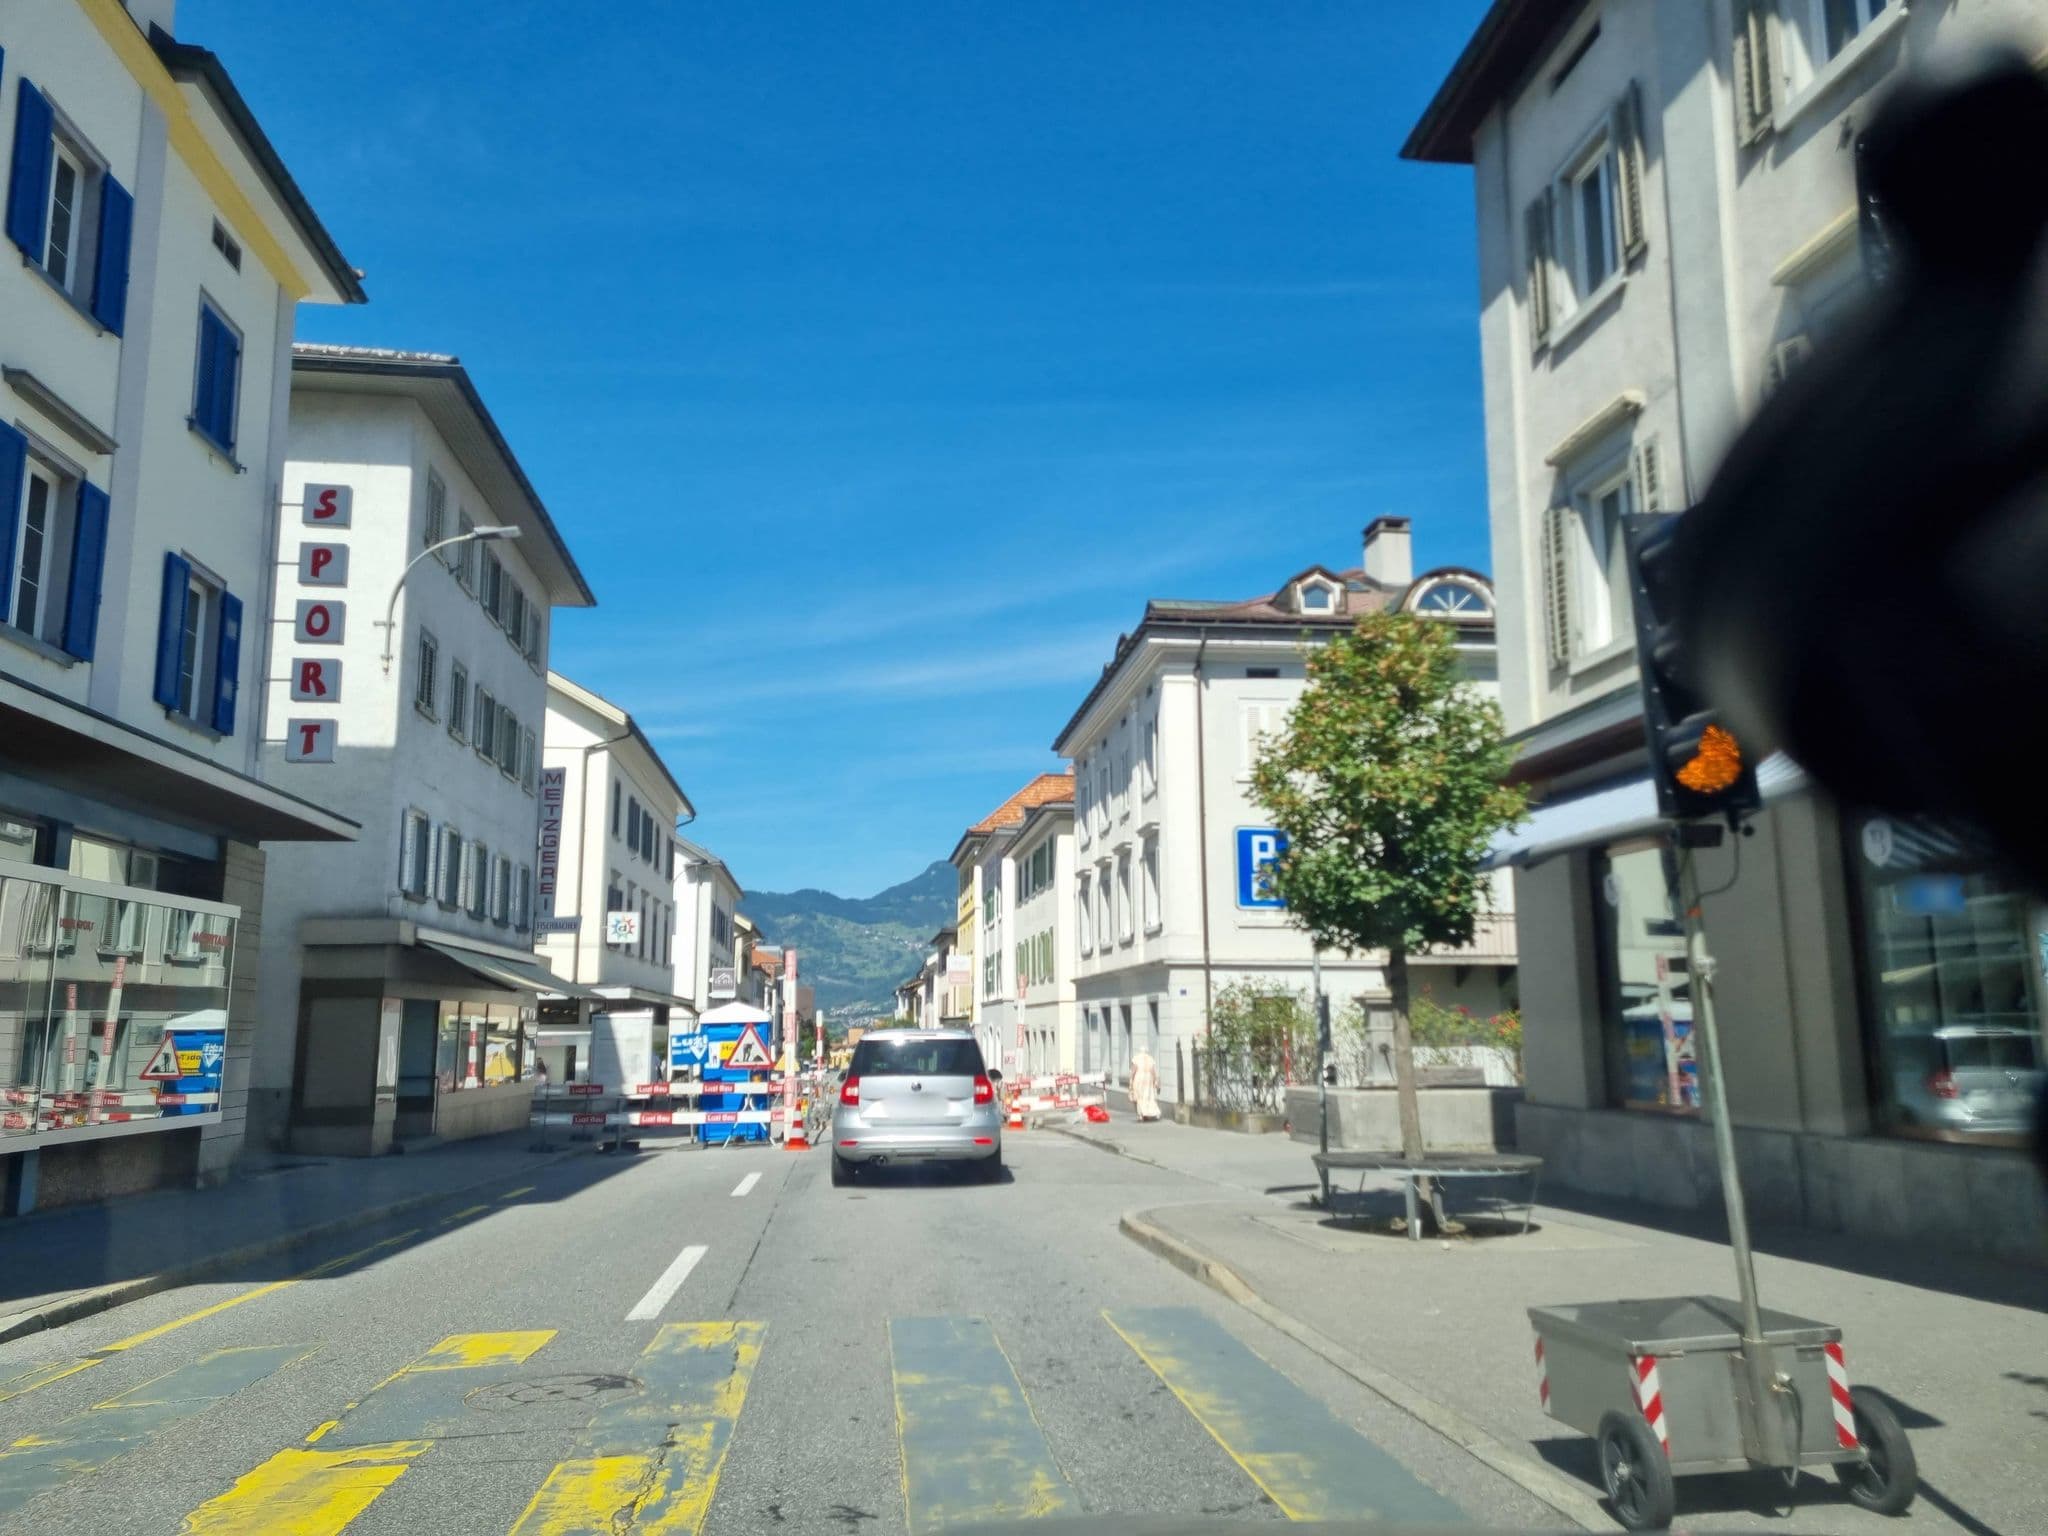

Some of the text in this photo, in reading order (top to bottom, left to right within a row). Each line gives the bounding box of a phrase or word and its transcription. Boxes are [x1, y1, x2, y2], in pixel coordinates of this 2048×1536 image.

[300, 489, 337, 755] SPORT
[539, 773, 562, 912] METZGEREI
[1252, 835, 1277, 872] P
